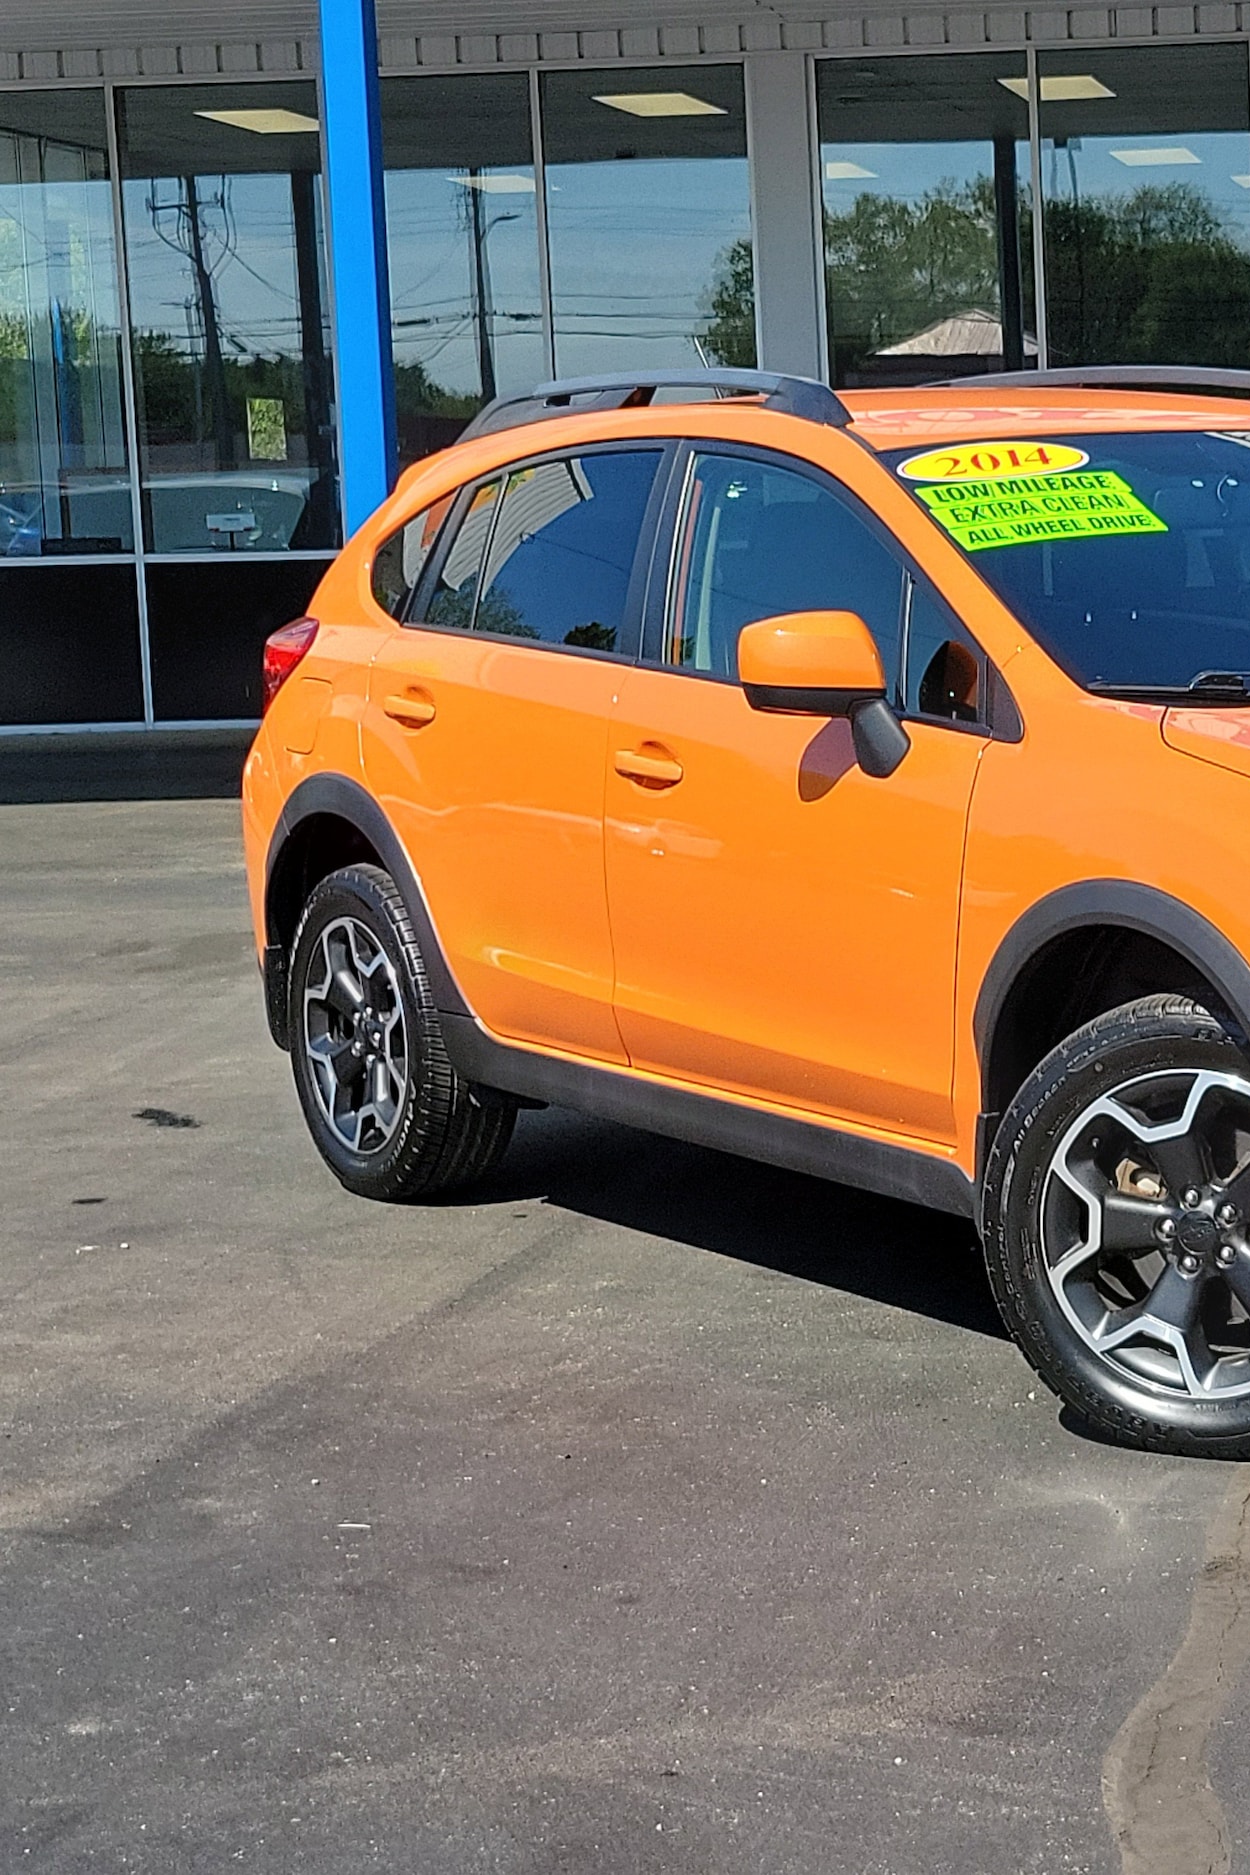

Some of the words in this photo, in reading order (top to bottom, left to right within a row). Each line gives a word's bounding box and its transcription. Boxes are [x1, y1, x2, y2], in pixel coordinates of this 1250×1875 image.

[935, 447, 1052, 477] 2014
[932, 483, 990, 503] LOW
[995, 474, 1110, 495] MILEAGE
[949, 499, 1041, 523] EXTRA
[1042, 493, 1125, 513] CLEAN
[968, 527, 1008, 544] ALL
[1010, 518, 1085, 537] WHEEL
[1088, 513, 1151, 530] DRIVE
